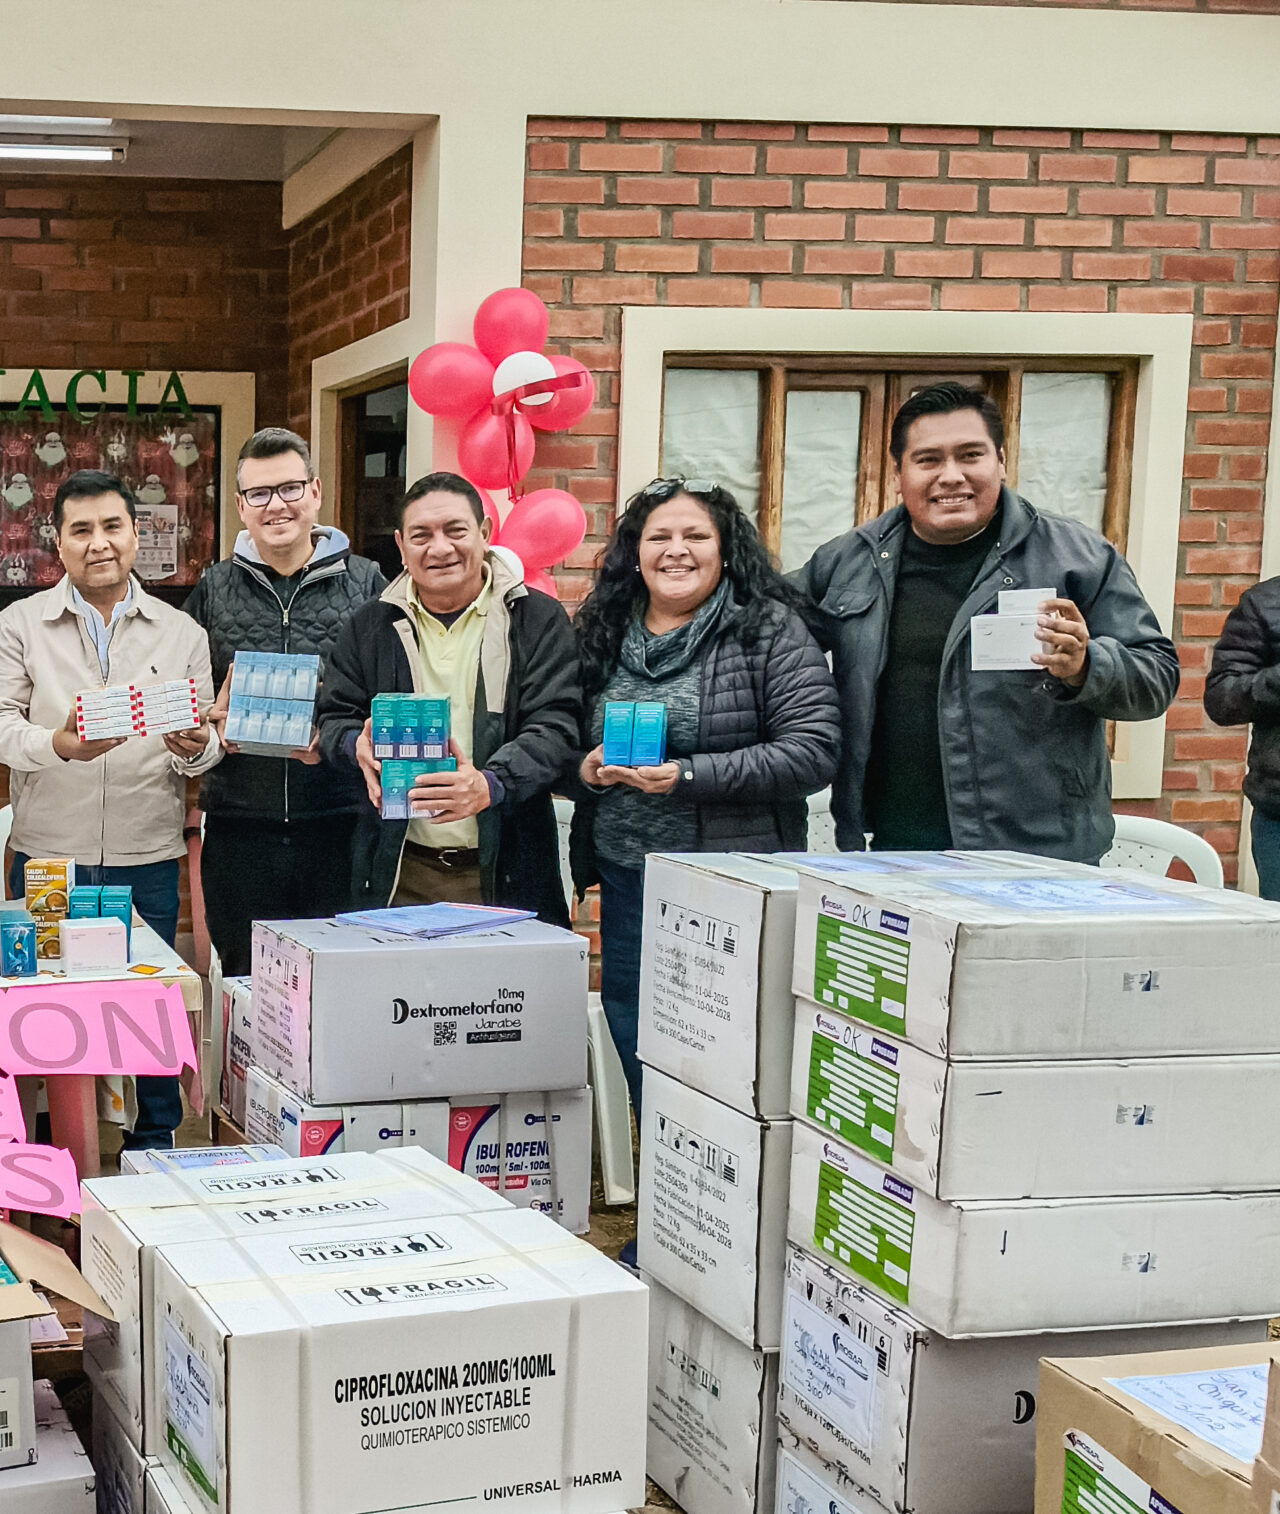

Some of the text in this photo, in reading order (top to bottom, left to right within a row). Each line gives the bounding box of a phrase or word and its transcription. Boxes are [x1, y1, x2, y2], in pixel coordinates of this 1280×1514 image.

[852, 904, 872, 928] OK
[391, 997, 523, 1025] Dextrometorfano
[475, 1018, 522, 1030] Jarabe
[843, 1026, 862, 1058] OK
[249, 1098, 285, 1132] IBUPROFENO
[208, 1175, 305, 1192] FRAGIL
[282, 1199, 379, 1217] FRAGIL
[299, 1244, 405, 1262] FRAGIL
[386, 1275, 495, 1295] FRAGIL
[880, 1335, 886, 1348] 6
[334, 1353, 556, 1404] CIPROFLOXACINA 200MG/100ML
[360, 1386, 532, 1428] SOLUCION INYECTABLE
[360, 1412, 531, 1451] QUIMIOTERAPICO SISTEMICO
[483, 1478, 562, 1501] UNIVERSAL
